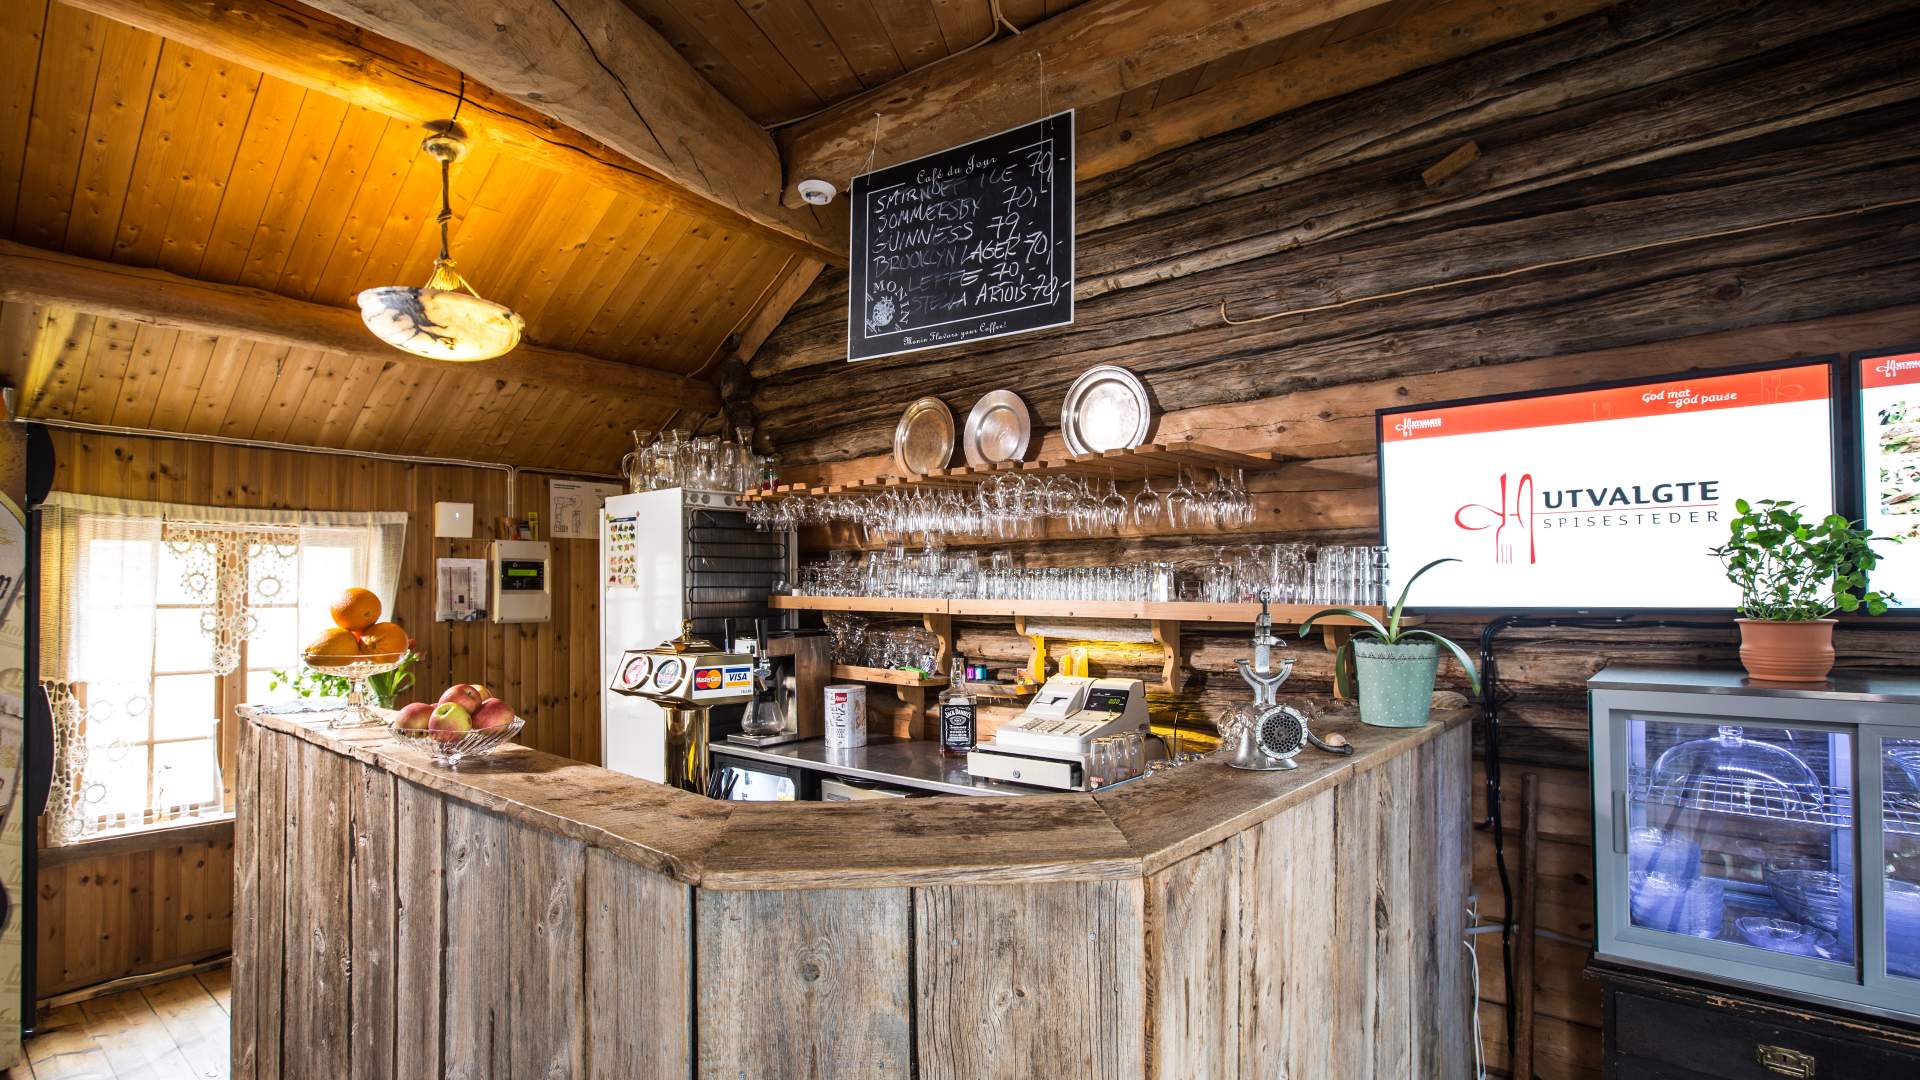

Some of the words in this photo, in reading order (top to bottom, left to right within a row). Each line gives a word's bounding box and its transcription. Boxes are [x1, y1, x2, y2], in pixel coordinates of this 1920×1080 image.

[916, 167, 943, 185] Café
[947, 165, 961, 177] du
[965, 154, 997, 175] Jour
[877, 195, 983, 233] SOMMERSBY
[872, 221, 974, 254] GUINNESS
[872, 244, 957, 279] BROOKLYN
[960, 236, 1021, 265] LAGER
[908, 268, 984, 292] LEFFE
[974, 281, 1031, 306] ARTOIS
[1642, 389, 1666, 403] God
[1667, 388, 1691, 399] mat
[1701, 392, 1738, 404] pause
[1541, 480, 1719, 509] UTVALGTE
[1543, 510, 1719, 529] SPISESTEDER
[729, 673, 748, 682] VISA
